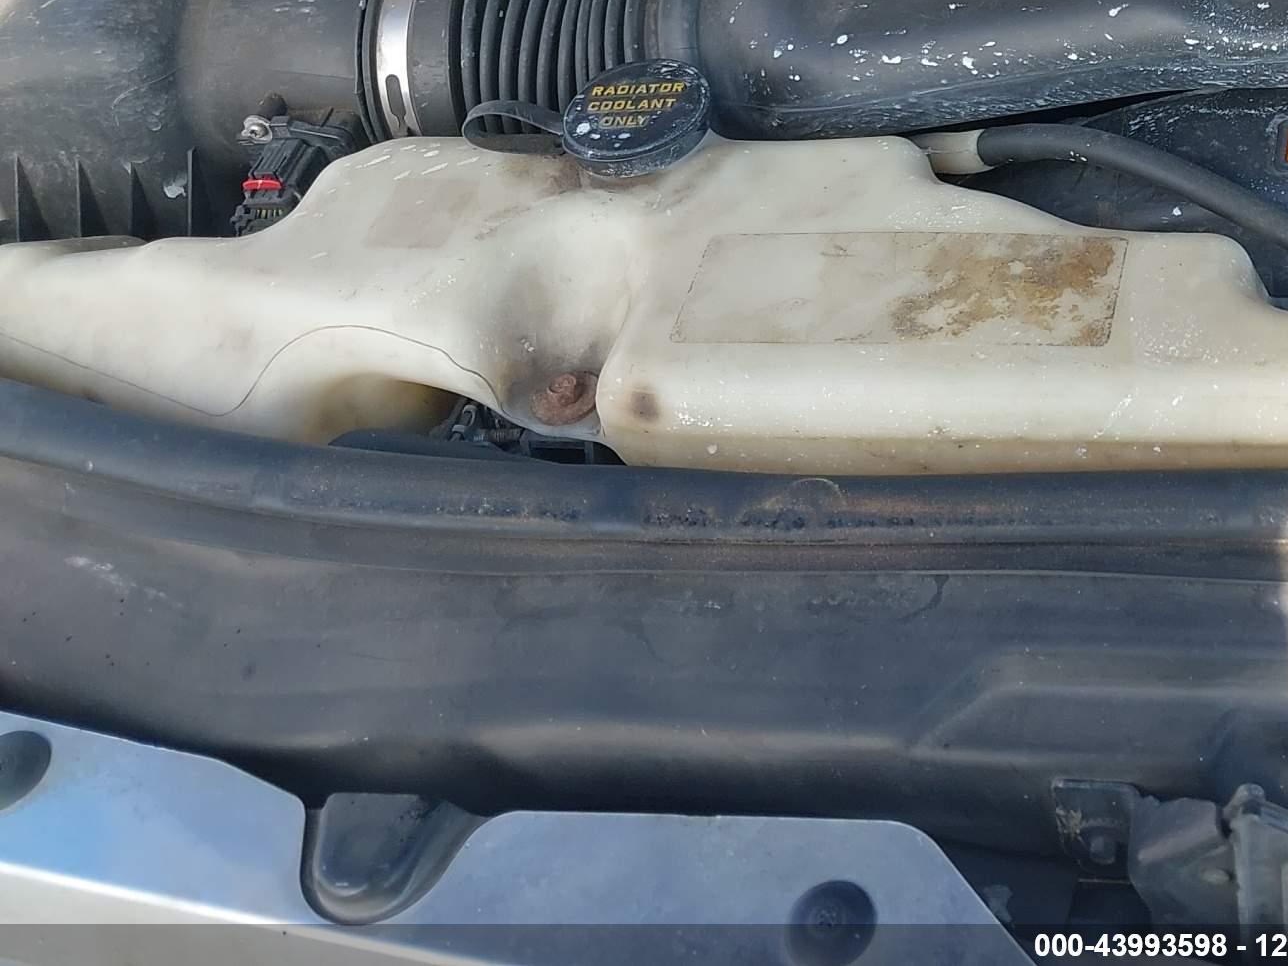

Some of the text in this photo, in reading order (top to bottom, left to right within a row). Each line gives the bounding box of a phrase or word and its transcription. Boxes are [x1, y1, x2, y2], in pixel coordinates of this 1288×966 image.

[591, 82, 686, 96] RADIATOR
[587, 98, 677, 111] COOLANT
[600, 114, 650, 128] ONLY
